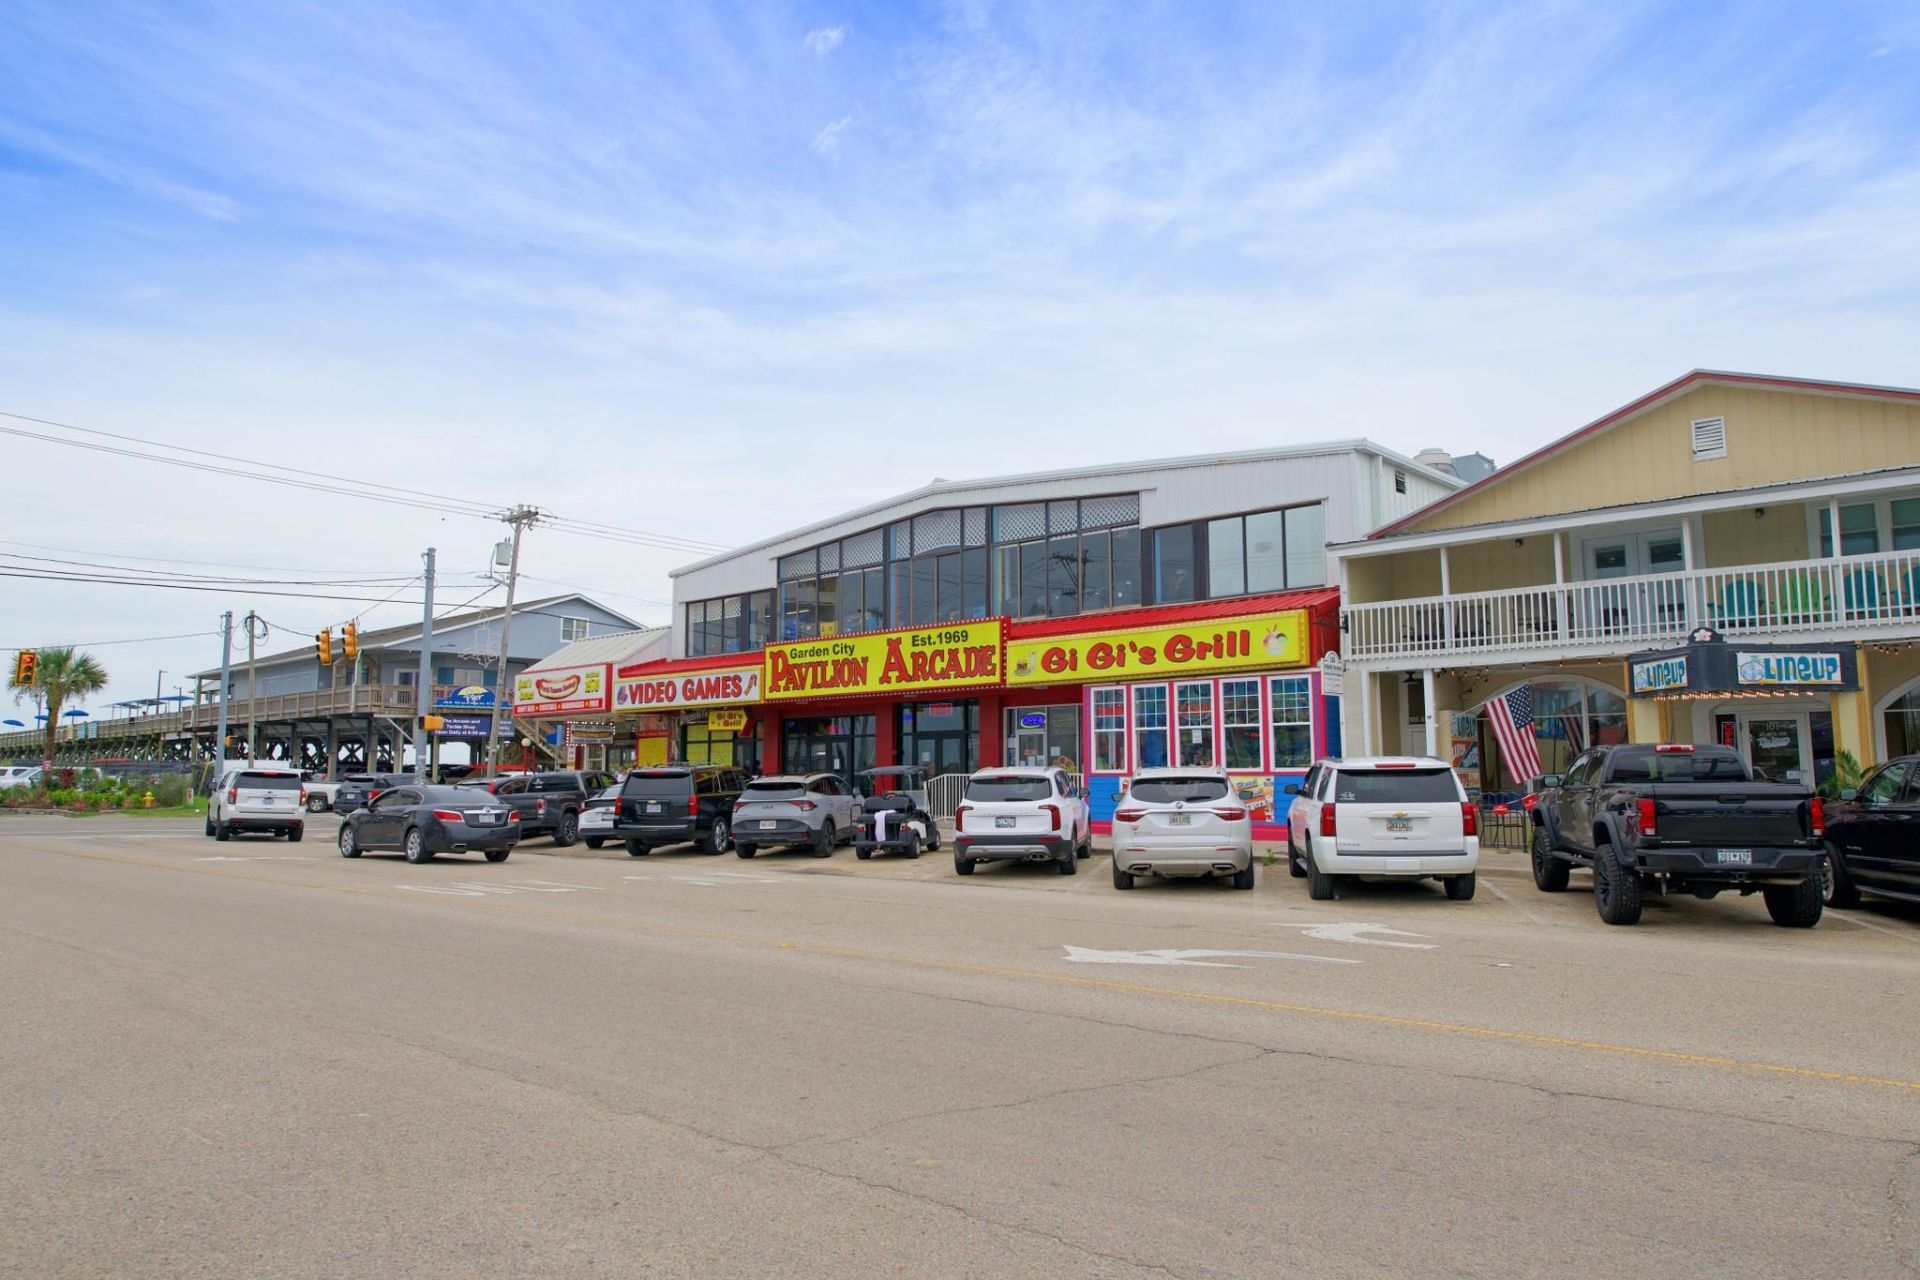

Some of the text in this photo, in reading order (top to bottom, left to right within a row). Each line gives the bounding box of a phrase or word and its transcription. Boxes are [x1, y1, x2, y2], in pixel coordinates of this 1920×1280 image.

[790, 643, 855, 659] Garden City
[1040, 629, 1251, 674] Gi Gi's Grill
[628, 680, 677, 705] VIDEO
[681, 674, 742, 702] GAMES
[1023, 714, 1044, 725] OPEN
